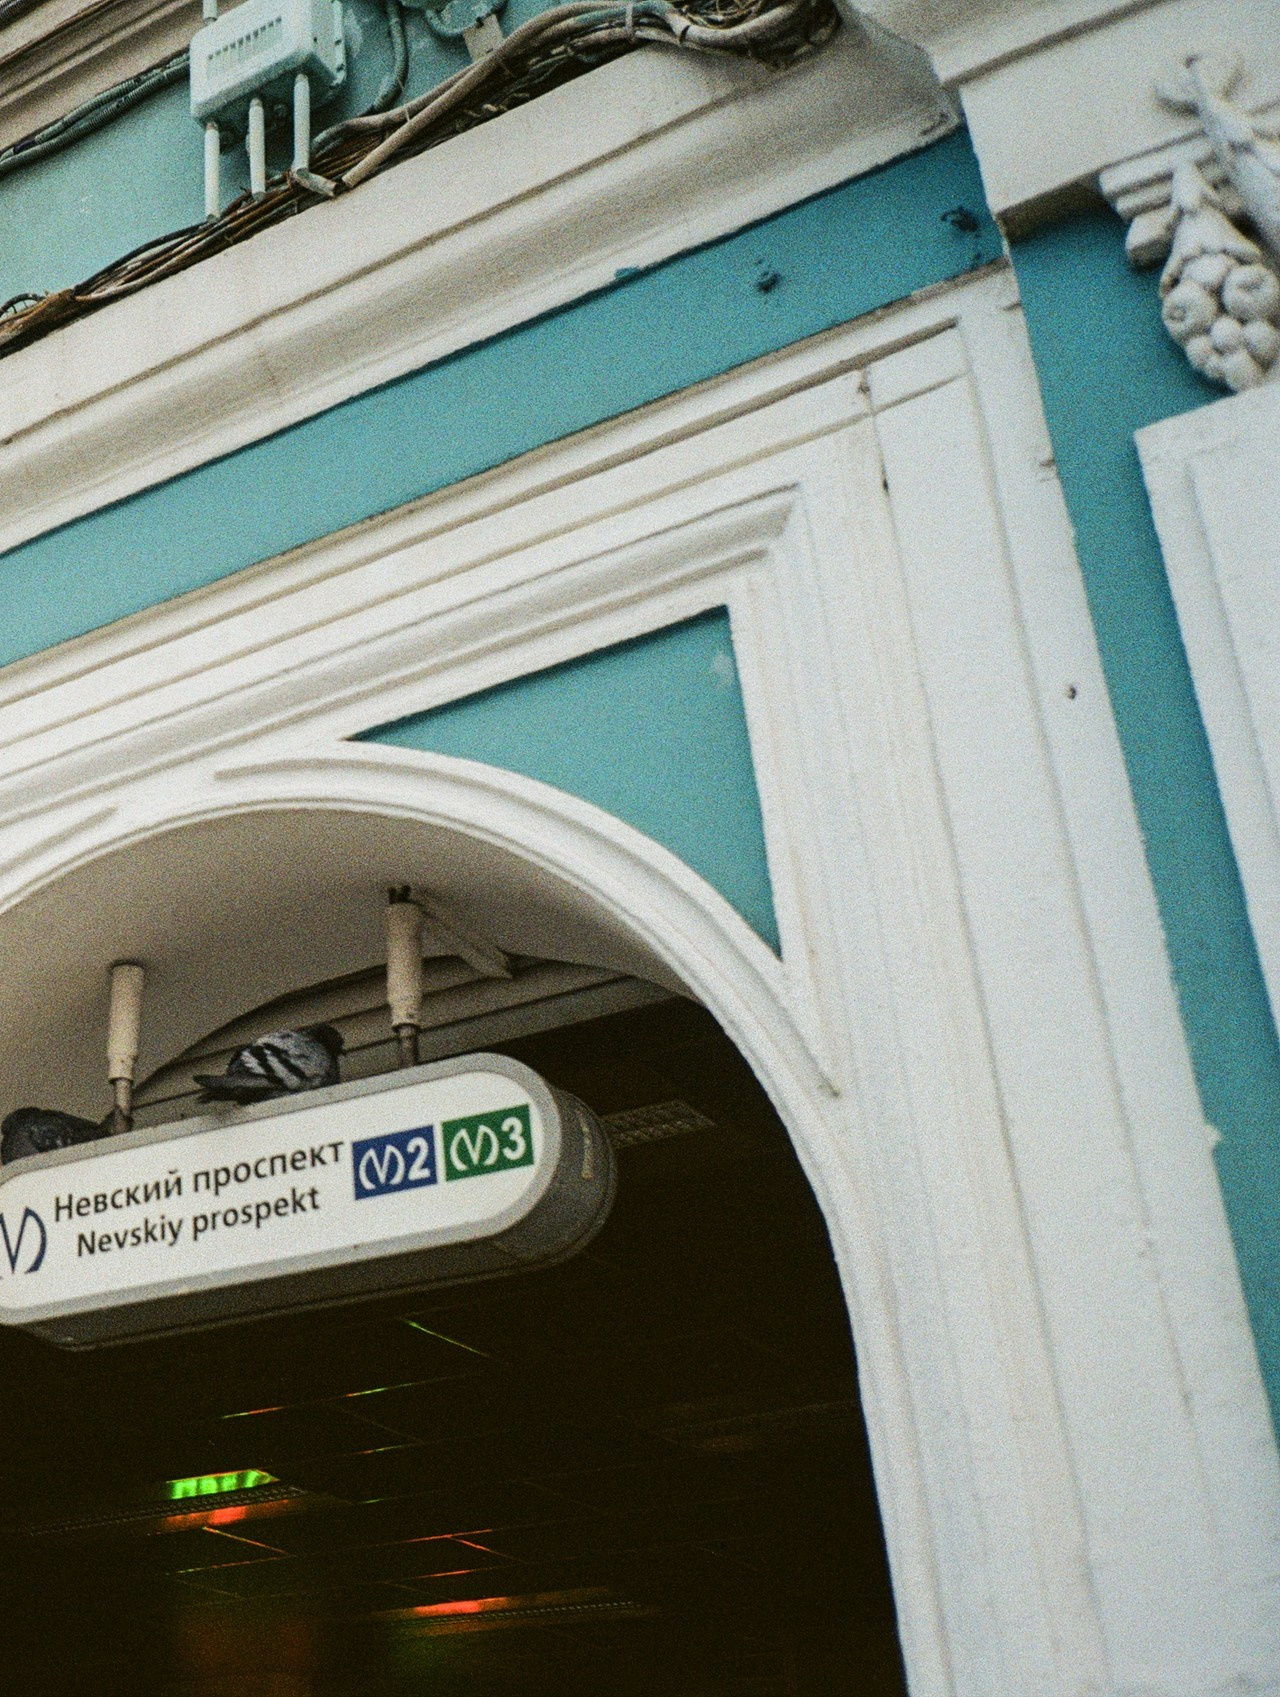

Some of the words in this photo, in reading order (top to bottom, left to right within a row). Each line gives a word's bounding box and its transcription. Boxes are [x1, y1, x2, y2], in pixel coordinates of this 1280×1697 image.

[54, 1170, 183, 1222] Невский
[193, 1140, 346, 1195] проспект
[76, 1209, 183, 1257] Nevskiy
[192, 1185, 321, 1241] prospekt
